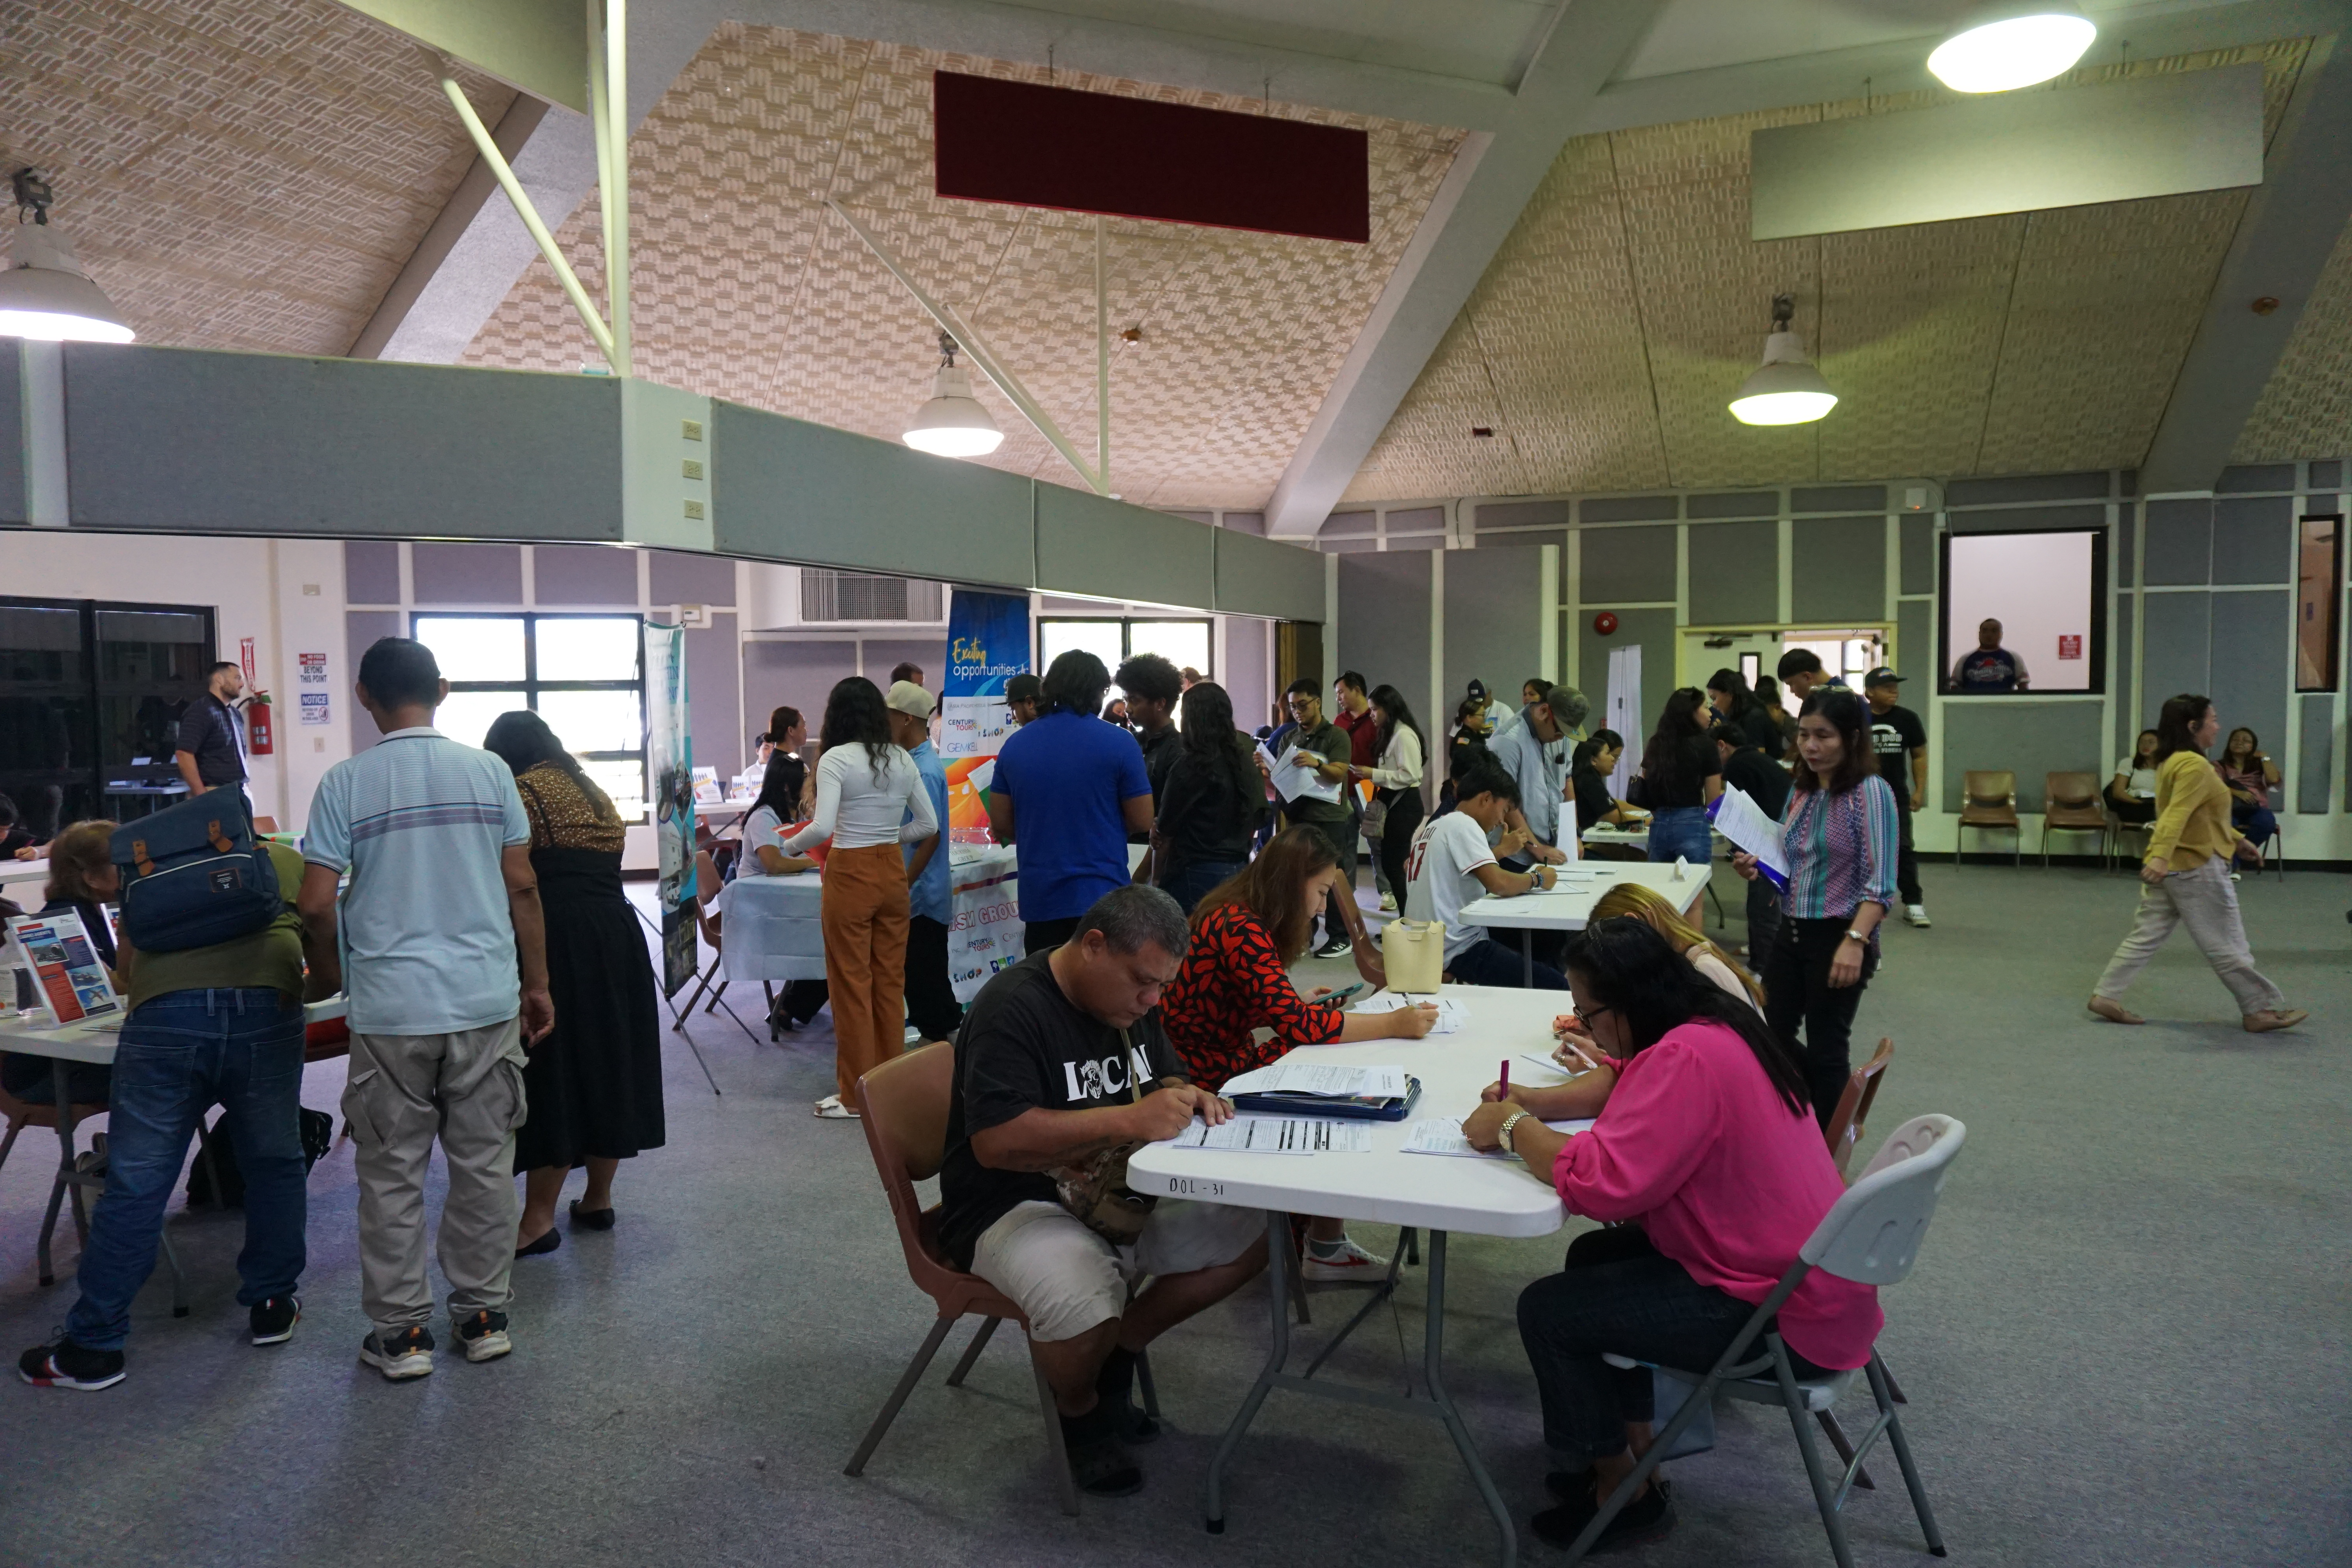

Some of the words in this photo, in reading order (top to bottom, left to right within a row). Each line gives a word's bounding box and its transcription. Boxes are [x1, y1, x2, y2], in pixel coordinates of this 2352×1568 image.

[952, 637, 987, 667] Exciting
[300, 675, 311, 683] THIS
[312, 674, 327, 683] POINT
[304, 666, 323, 674] BEYOND
[953, 663, 1016, 681] opportunities
[302, 695, 327, 704] NOTICE
[1408, 842, 1427, 882] 17
[978, 901, 1019, 925] GROU
[973, 943, 990, 952] TOURS
[1169, 1177, 1196, 1194] DOL
[1212, 1183, 1224, 1196] 31
